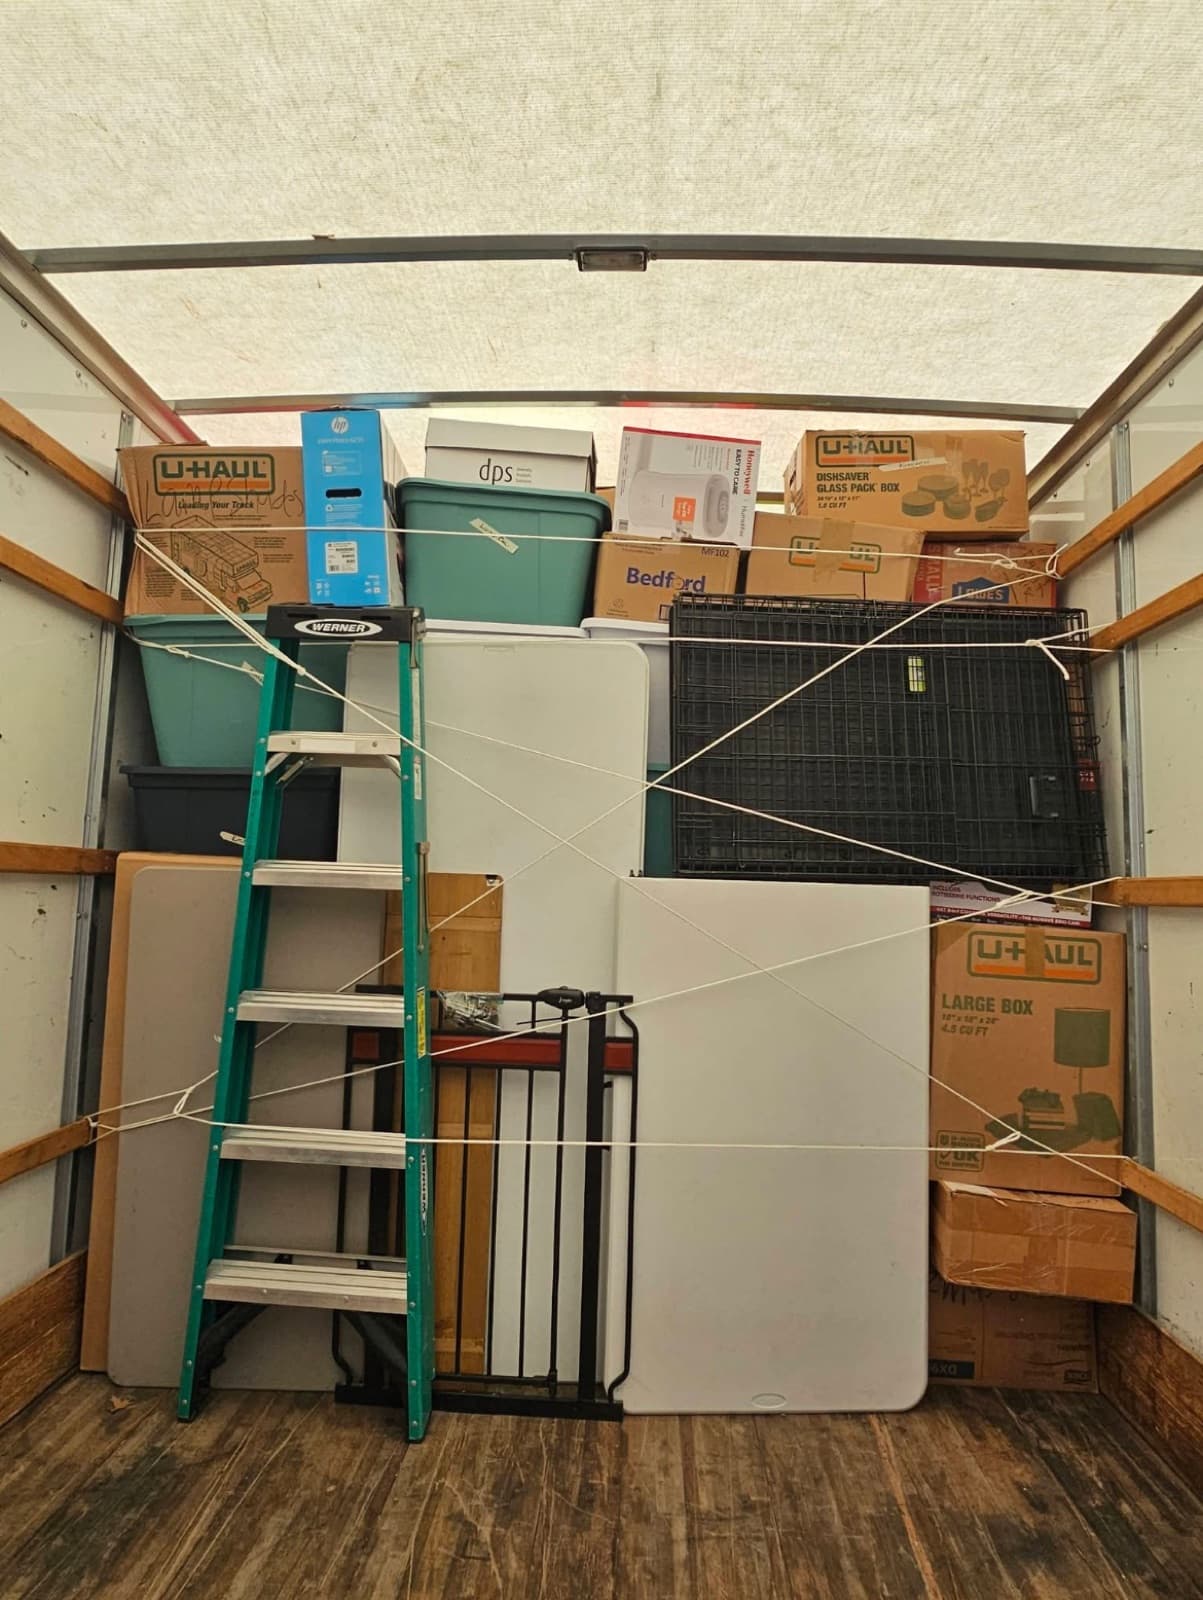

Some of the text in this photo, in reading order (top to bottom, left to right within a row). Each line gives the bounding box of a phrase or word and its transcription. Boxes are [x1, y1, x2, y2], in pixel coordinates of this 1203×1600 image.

[332, 416, 348, 433] hp
[823, 438, 908, 454] U-HAUL
[161, 460, 267, 479] U-HAUL
[479, 458, 513, 485] dps
[743, 449, 755, 495] Honeywell
[816, 472, 869, 481] DISHSAVER
[816, 483, 900, 493] GLASS PACK BOX
[212, 501, 229, 509] Your
[796, 541, 875, 562] U-UL
[312, 623, 366, 633] WERNER
[942, 993, 1033, 1015] LARGE BOX
